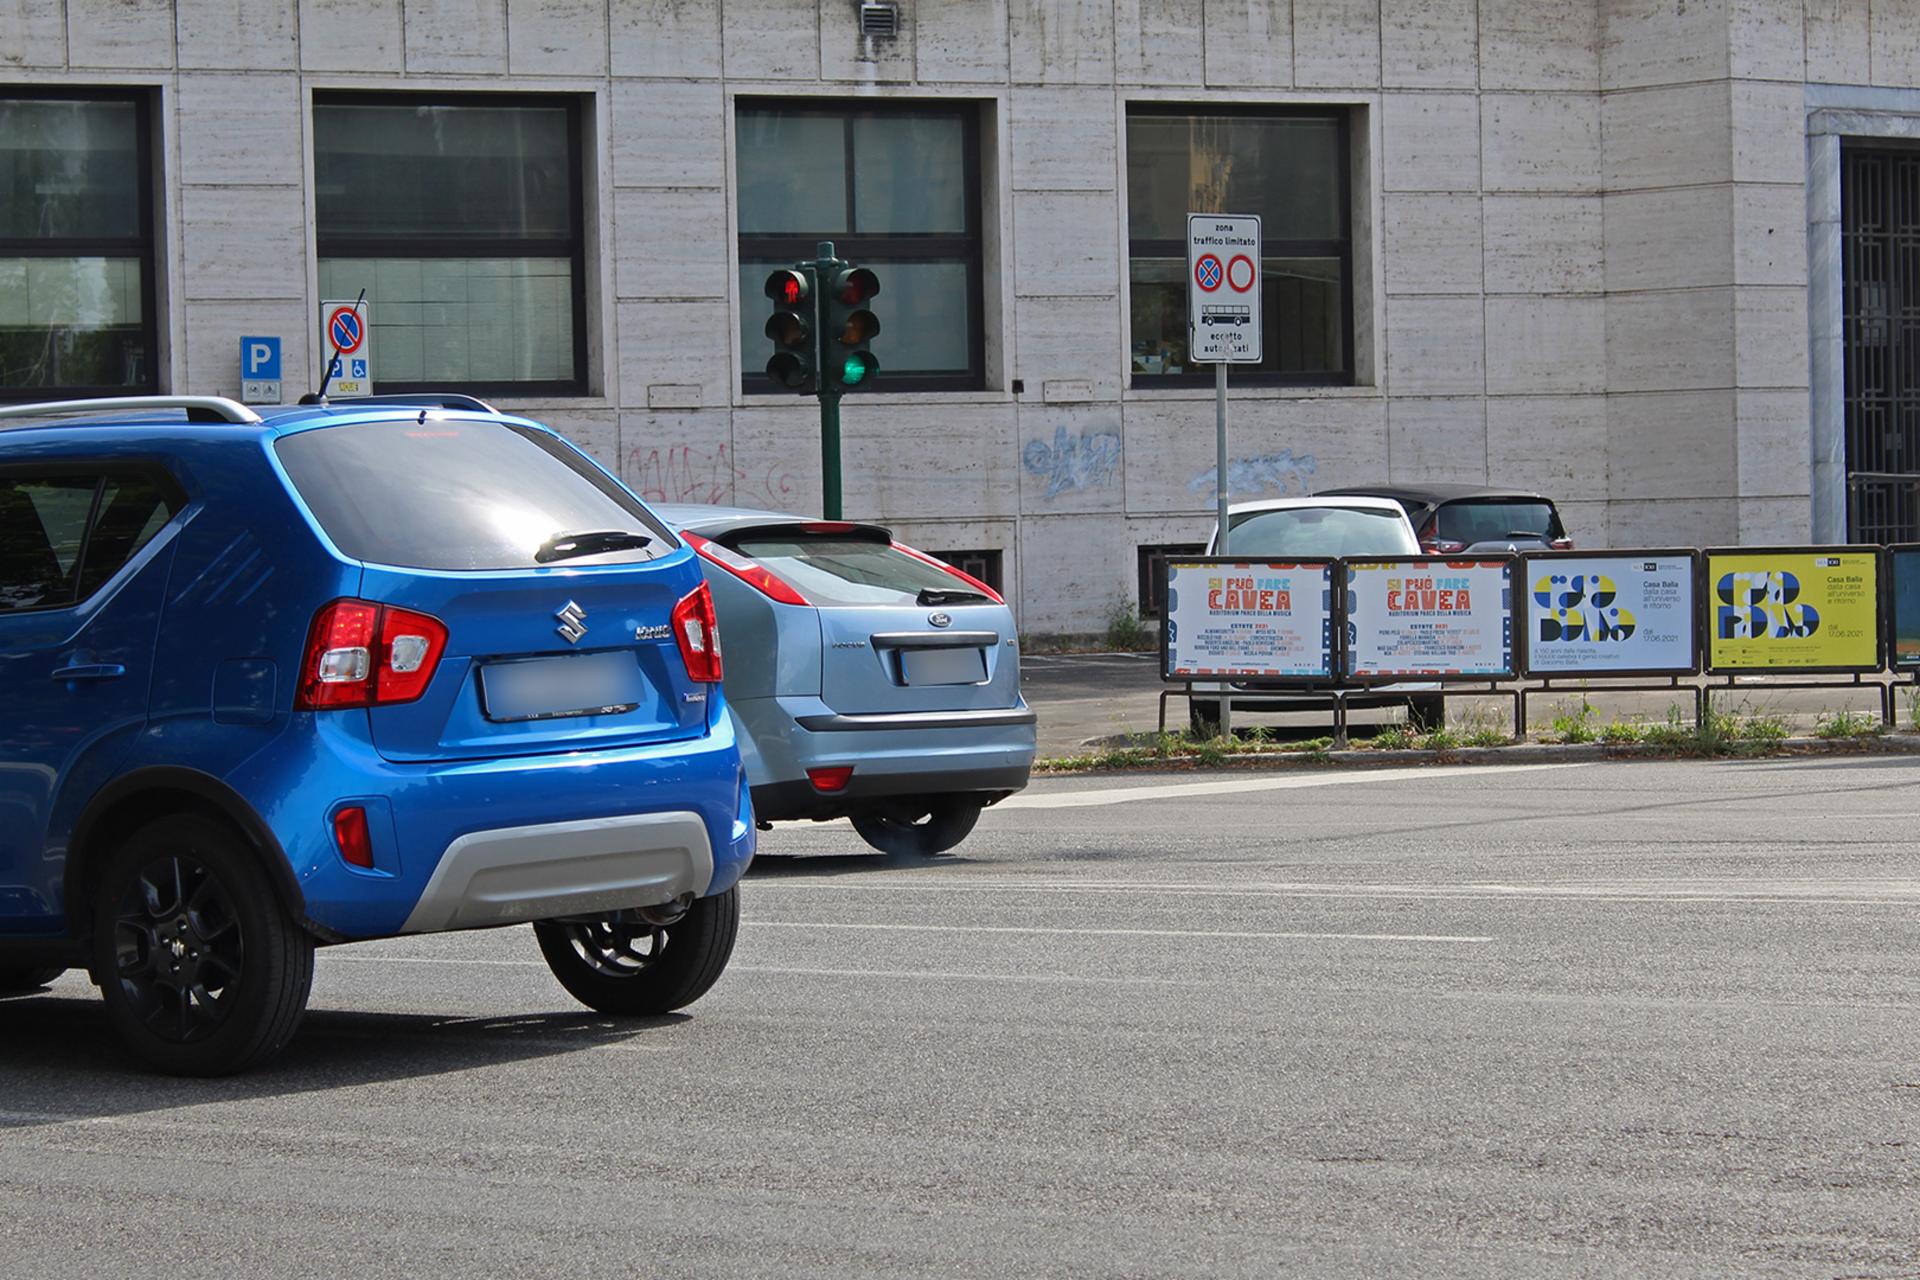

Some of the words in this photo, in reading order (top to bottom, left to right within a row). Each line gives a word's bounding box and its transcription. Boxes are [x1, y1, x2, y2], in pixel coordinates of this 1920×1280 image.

[1216, 224, 1233, 232] zona
[1194, 236, 1223, 245] traffico
[1225, 237, 1256, 246] limitato
[1210, 332, 1242, 340] ecctto
[250, 344, 272, 373] P
[1257, 578, 1290, 590] FARE
[1436, 578, 1470, 589] FARE
[1208, 590, 1291, 610] CAVEA
[1388, 590, 1470, 610] CAVEA
